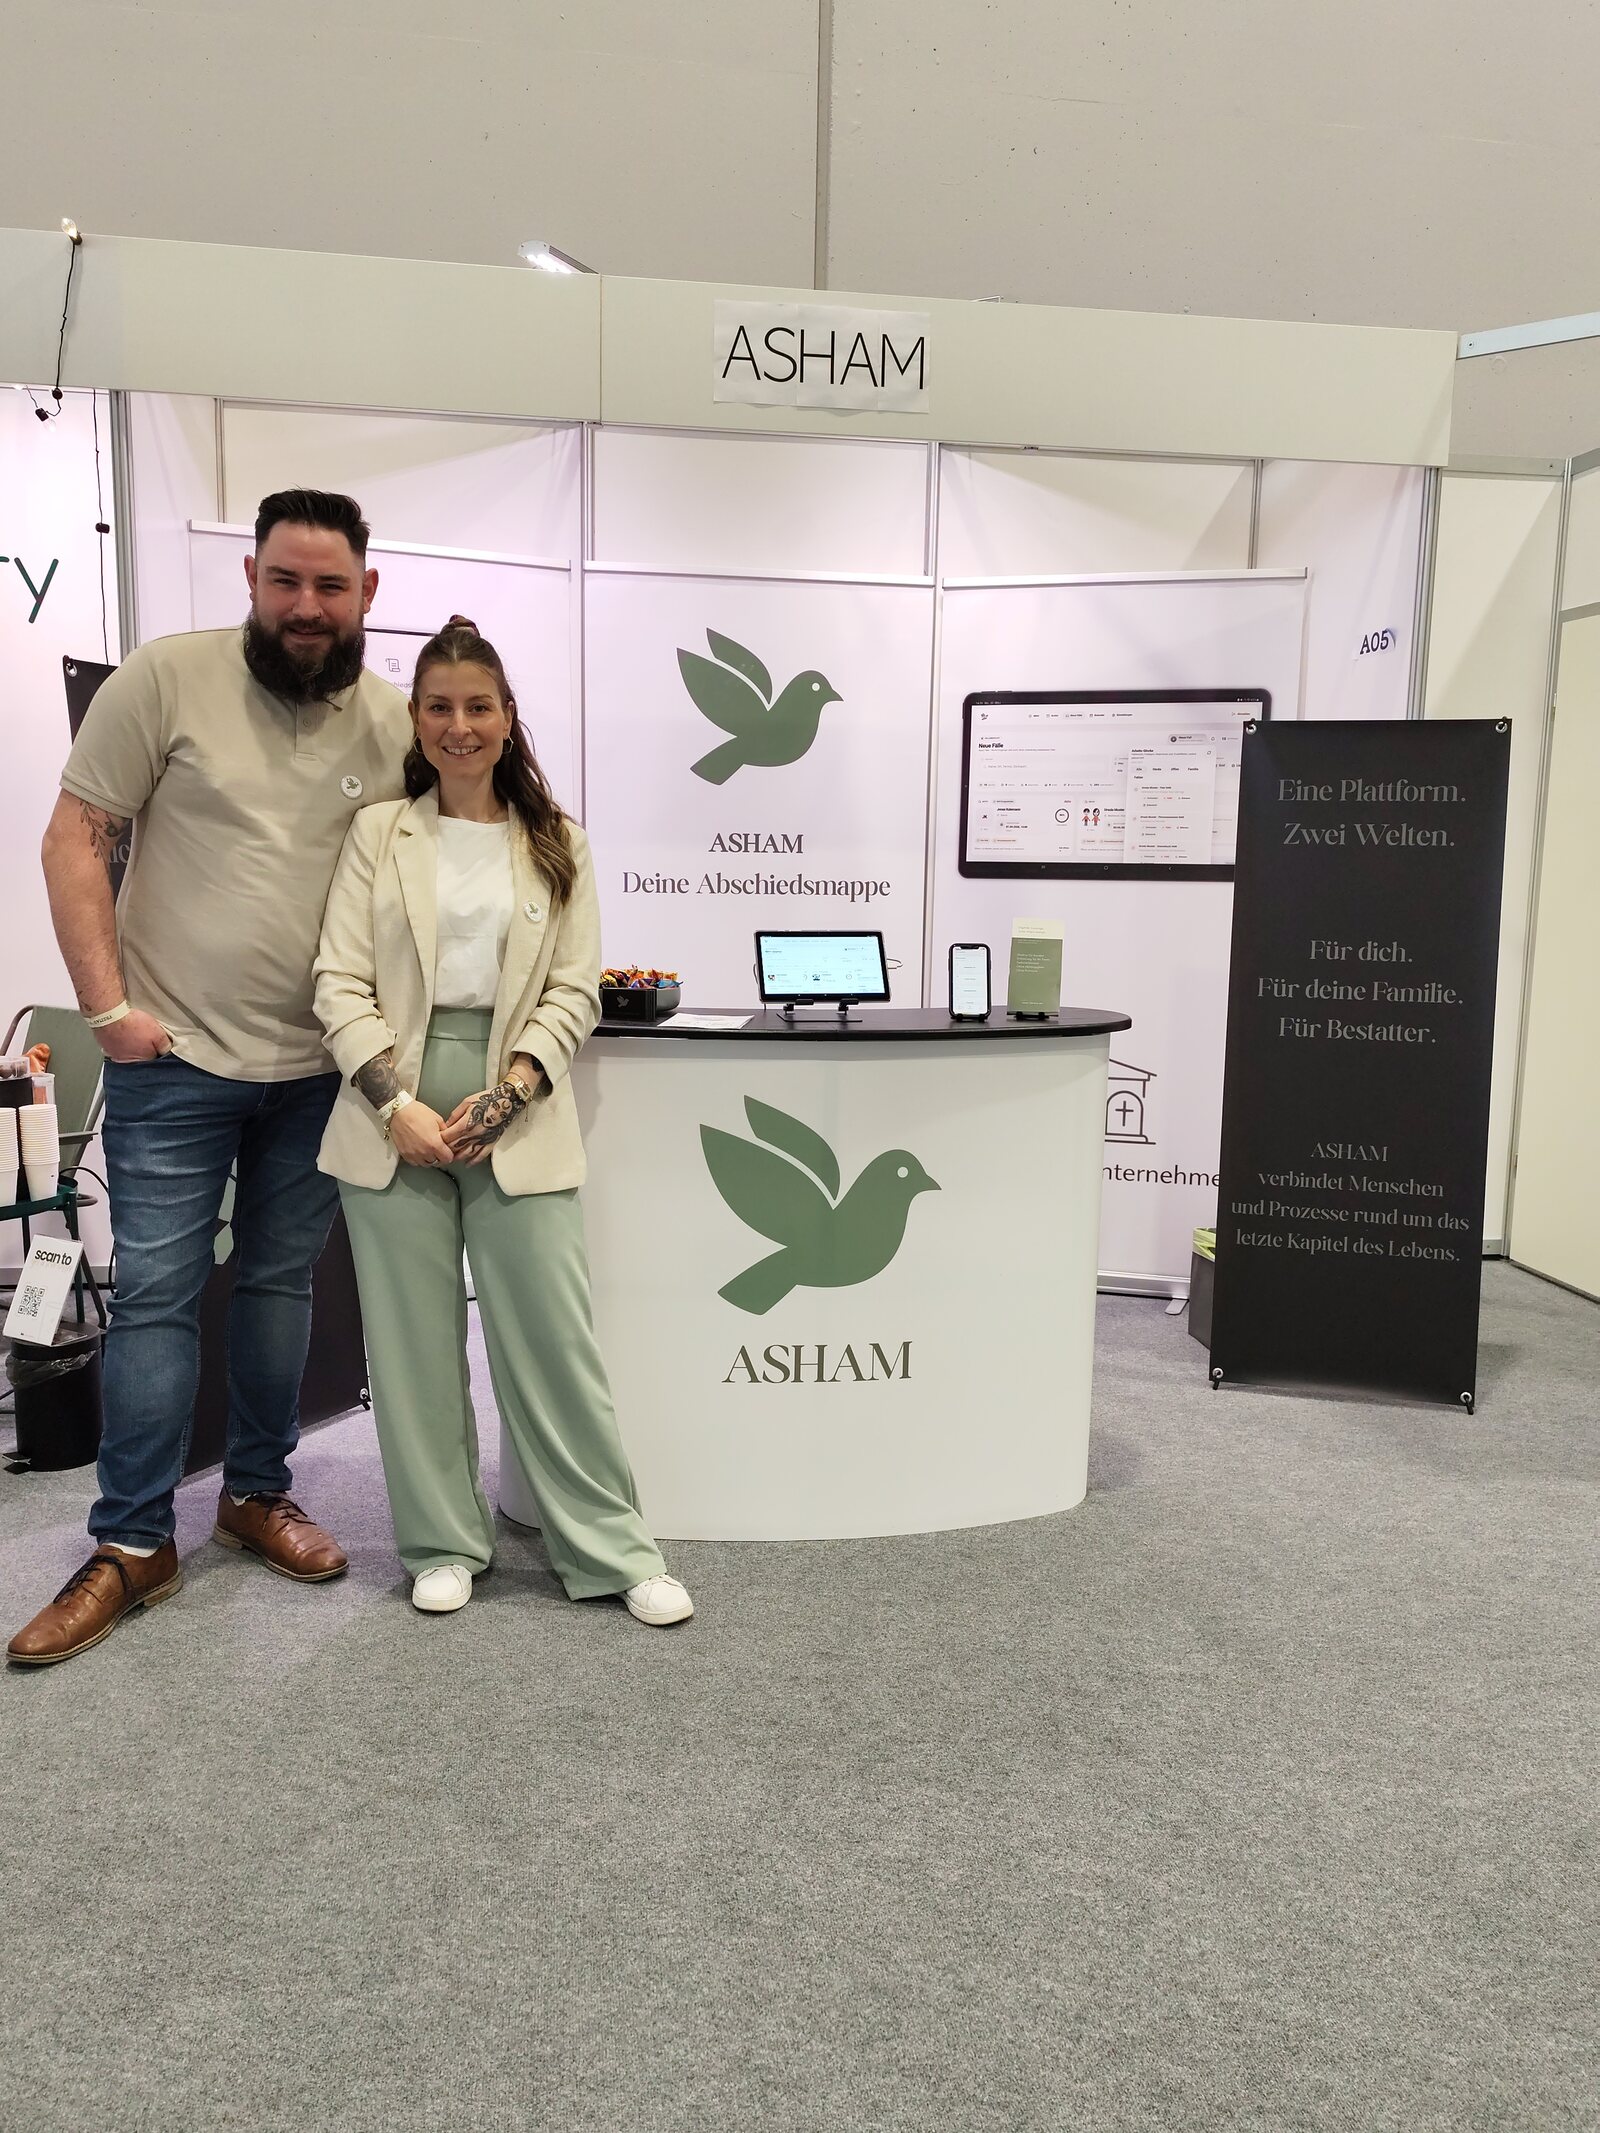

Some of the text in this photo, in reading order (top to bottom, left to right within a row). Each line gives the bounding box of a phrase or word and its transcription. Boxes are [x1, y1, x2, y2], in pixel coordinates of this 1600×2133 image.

[721, 325, 925, 390] ASHAM
[1359, 629, 1389, 655] A05
[1277, 778, 1466, 804] Eine Plattform.
[708, 832, 804, 854] ASHAM
[1283, 822, 1456, 848] Zwei Welten.
[622, 872, 892, 903] Deine Abschiedsmappe
[1309, 939, 1413, 963] Für dich.
[1257, 977, 1465, 1006] Für deine Familie.
[1279, 1016, 1437, 1045] Für Bestatter.
[1309, 1141, 1389, 1163] ASHAM
[1258, 1171, 1444, 1198] verbindet Menschen
[1231, 1199, 1470, 1232] und Prozesse rund um das
[34, 1249, 60, 1264] scan
[61, 1252, 72, 1266] to
[1235, 1228, 1461, 1262] letzte Kapitel des Lebens.
[721, 1341, 913, 1385] ASHAM
